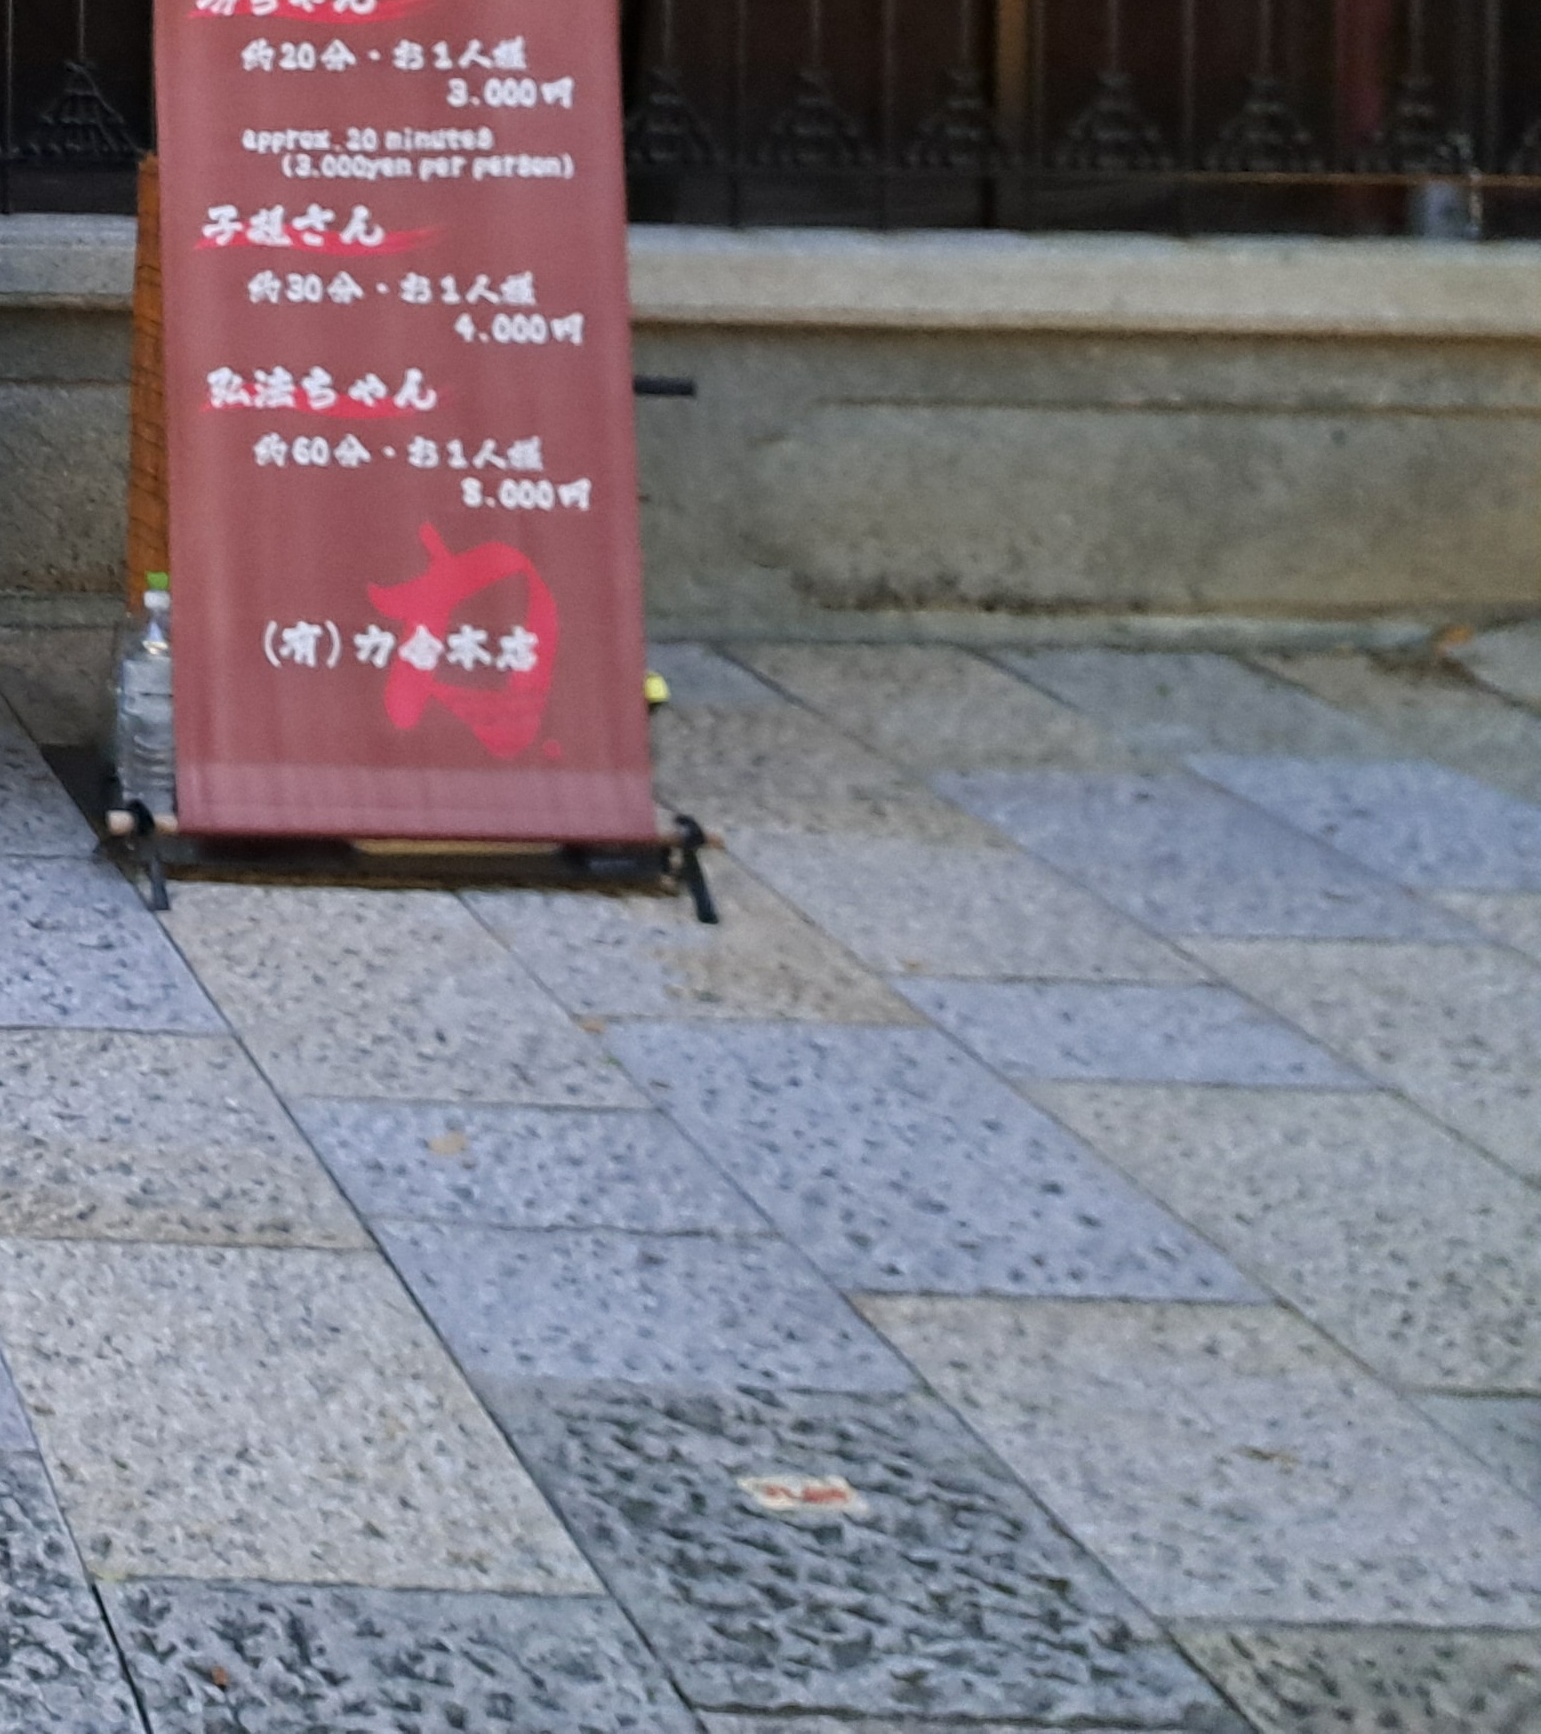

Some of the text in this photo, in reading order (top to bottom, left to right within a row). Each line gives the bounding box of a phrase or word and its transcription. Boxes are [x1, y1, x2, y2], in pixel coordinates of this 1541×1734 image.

[383, 125, 494, 151] minutes
[418, 155, 467, 182] per
[200, 203, 386, 248] 子規さん
